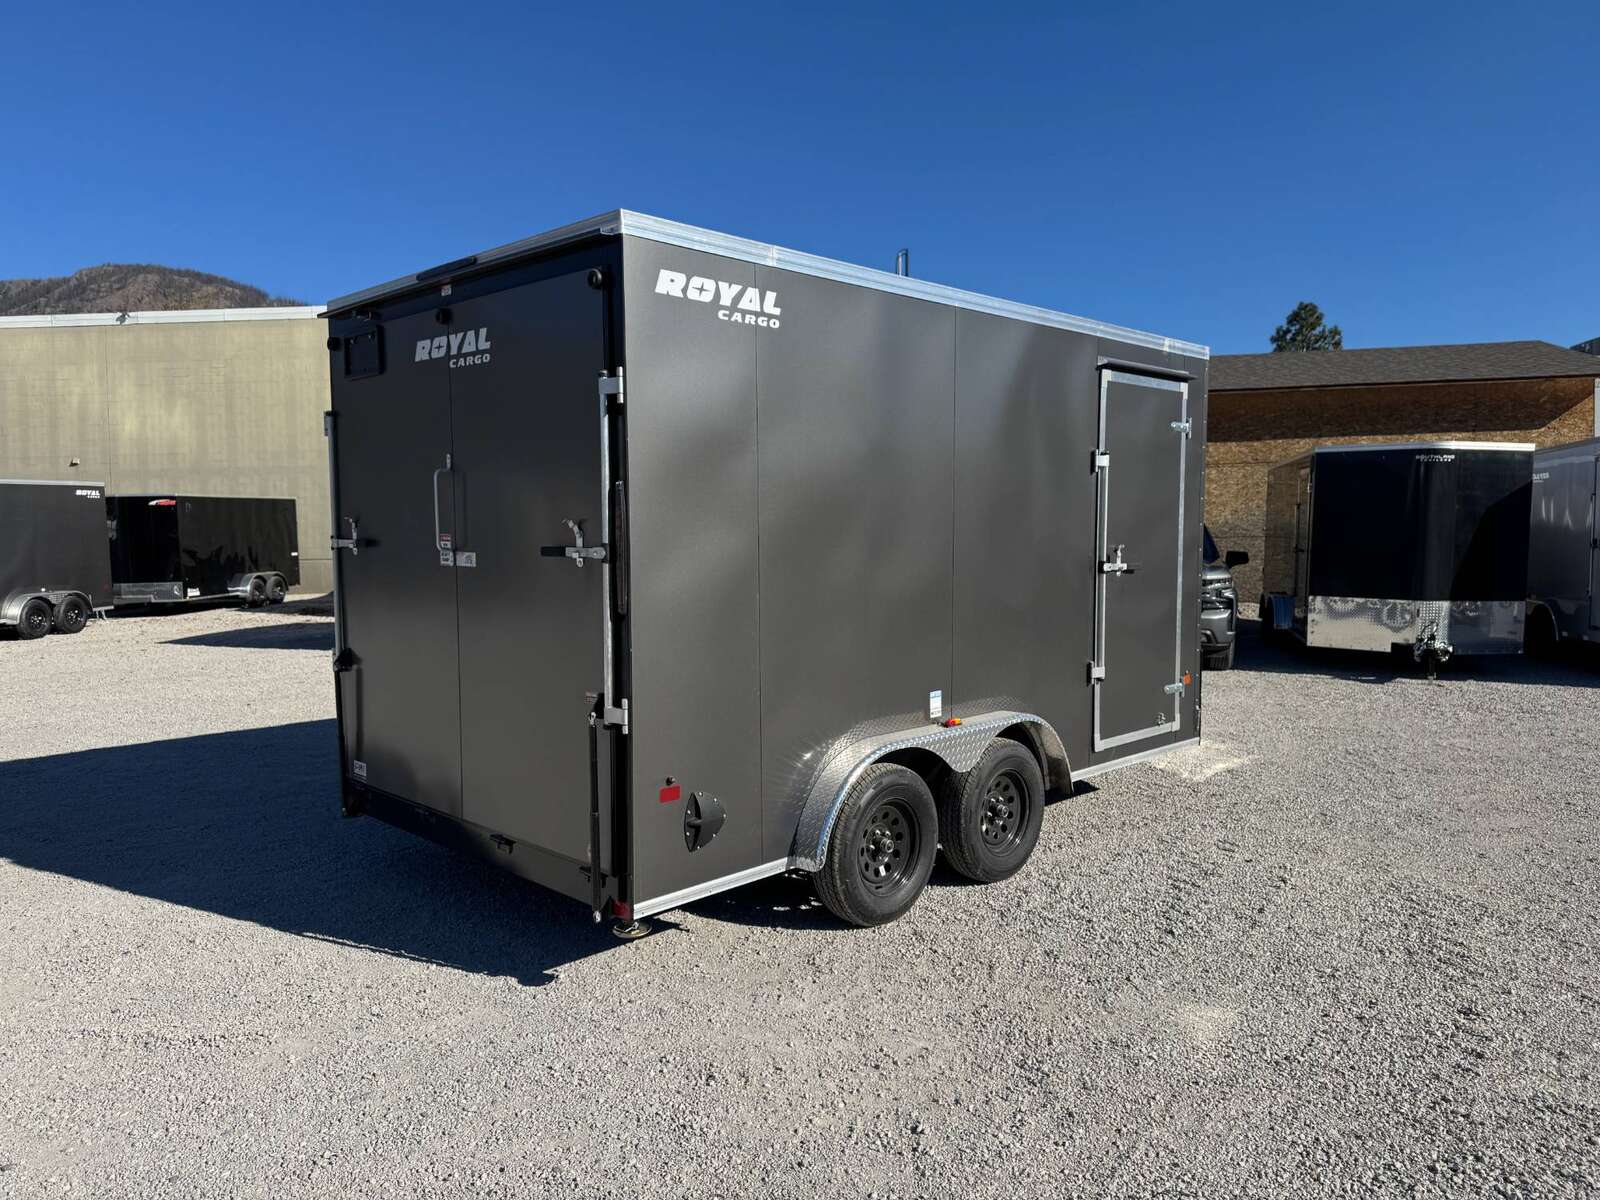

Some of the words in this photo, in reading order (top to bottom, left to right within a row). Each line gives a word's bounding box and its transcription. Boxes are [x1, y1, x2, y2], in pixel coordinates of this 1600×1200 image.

[655, 269, 781, 315] ROYAL
[717, 310, 780, 329] CARGO
[415, 327, 491, 362] ROYAL
[449, 353, 491, 368] CARGO
